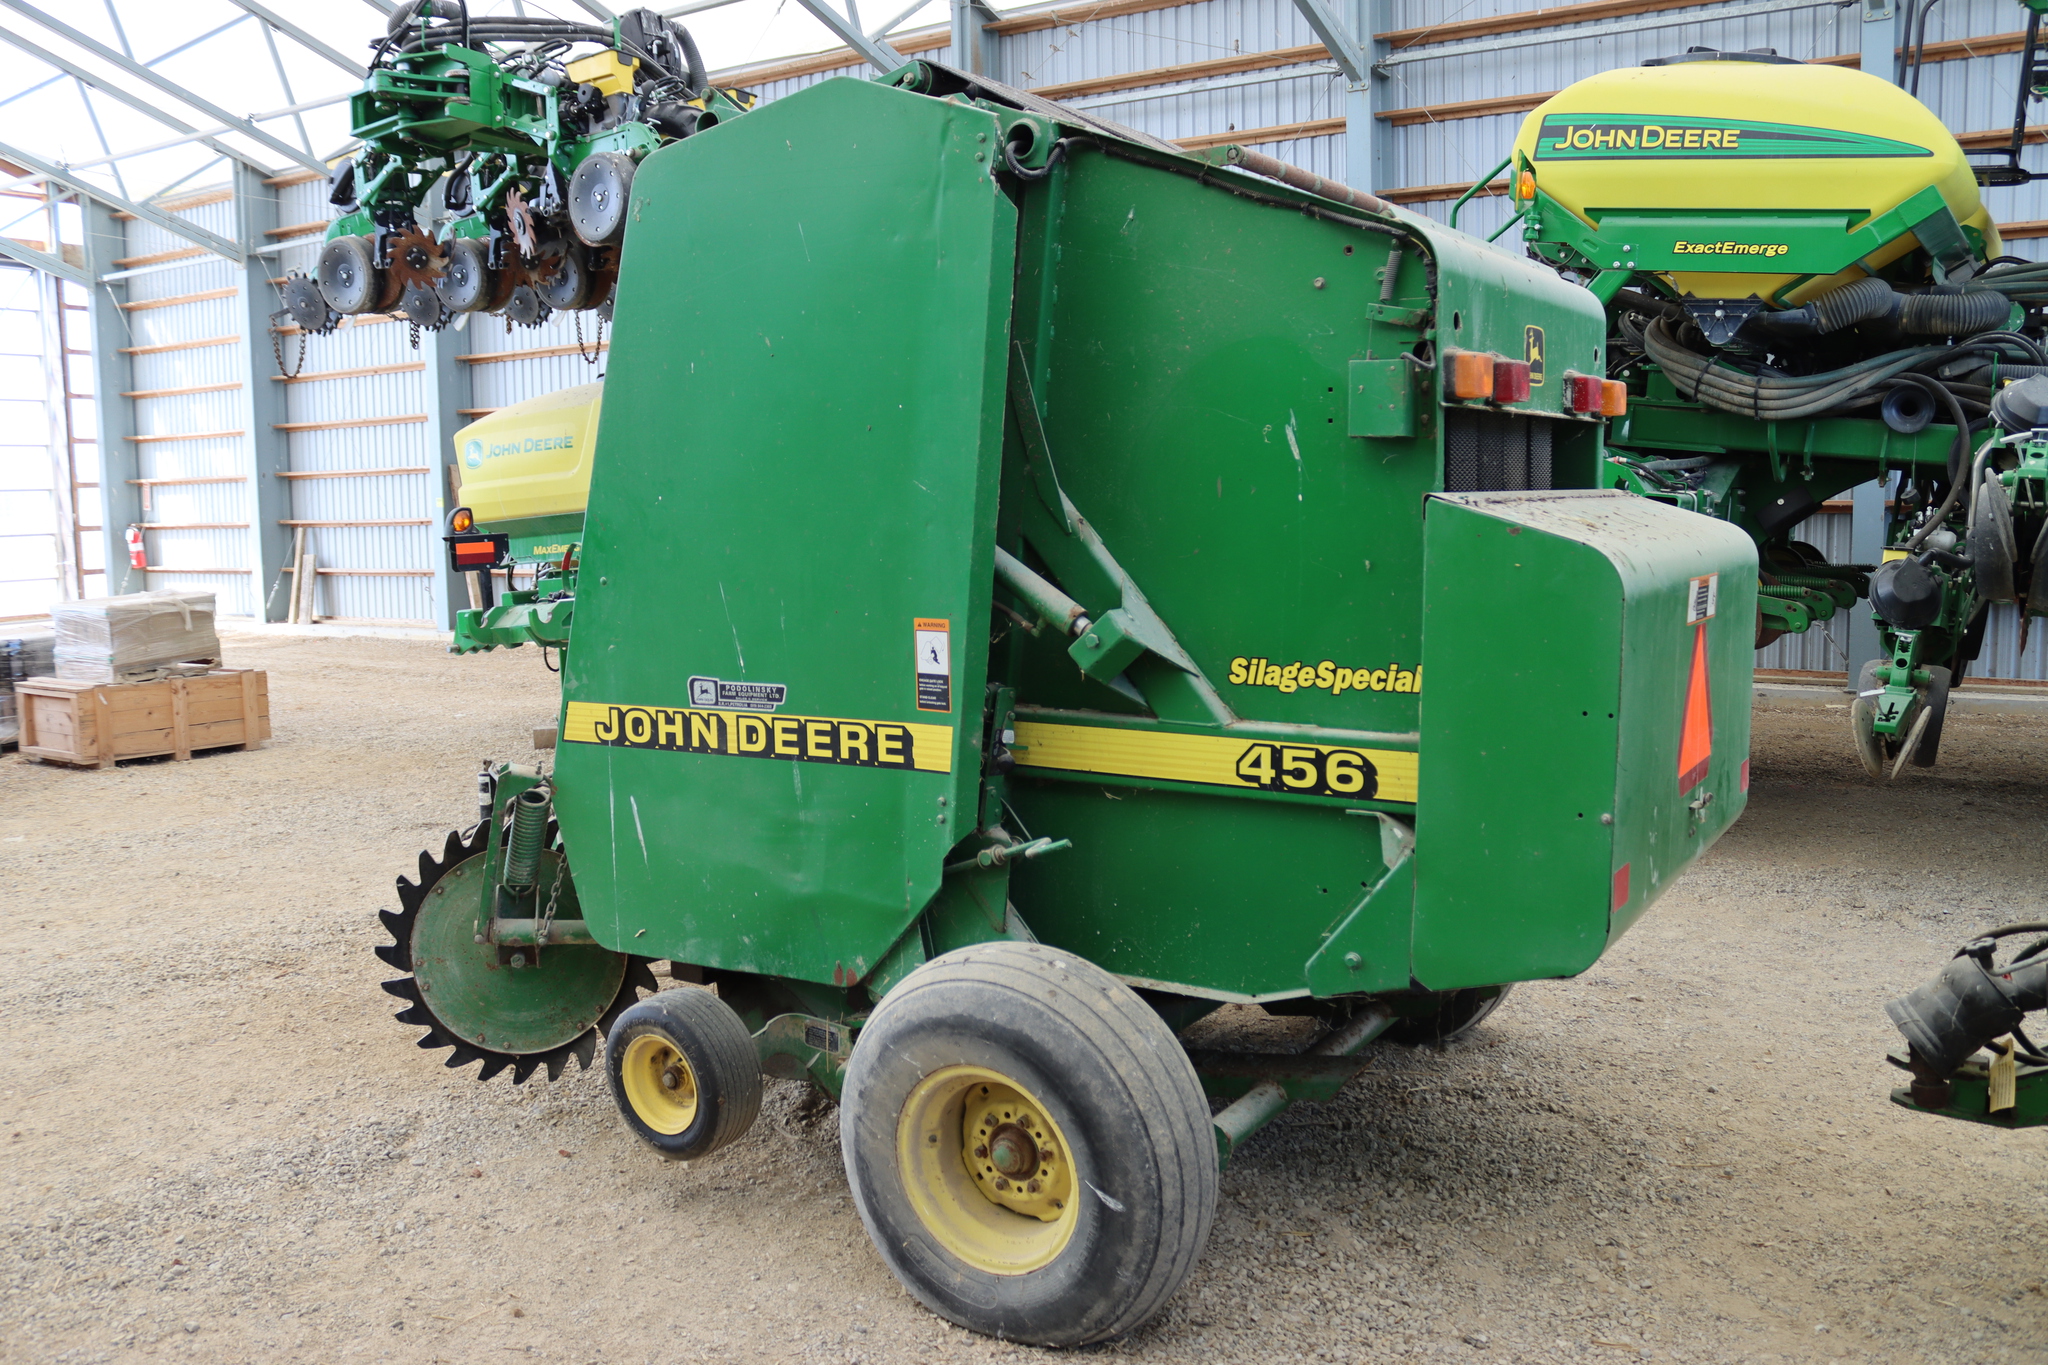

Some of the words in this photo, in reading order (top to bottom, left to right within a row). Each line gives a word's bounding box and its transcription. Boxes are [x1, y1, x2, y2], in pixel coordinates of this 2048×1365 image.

[1554, 125, 1638, 150] JOHN
[1640, 125, 1741, 150] DEERE
[1672, 240, 1789, 258] ExactEmerge
[486, 442, 521, 459] JOHN
[523, 436, 574, 453] DEERE
[1228, 656, 1422, 695] SilageSpecial
[725, 684, 777, 693] PODOLINSKY
[595, 706, 726, 755] JOHN
[735, 714, 913, 767] DEERE
[1236, 743, 1377, 799] 456
